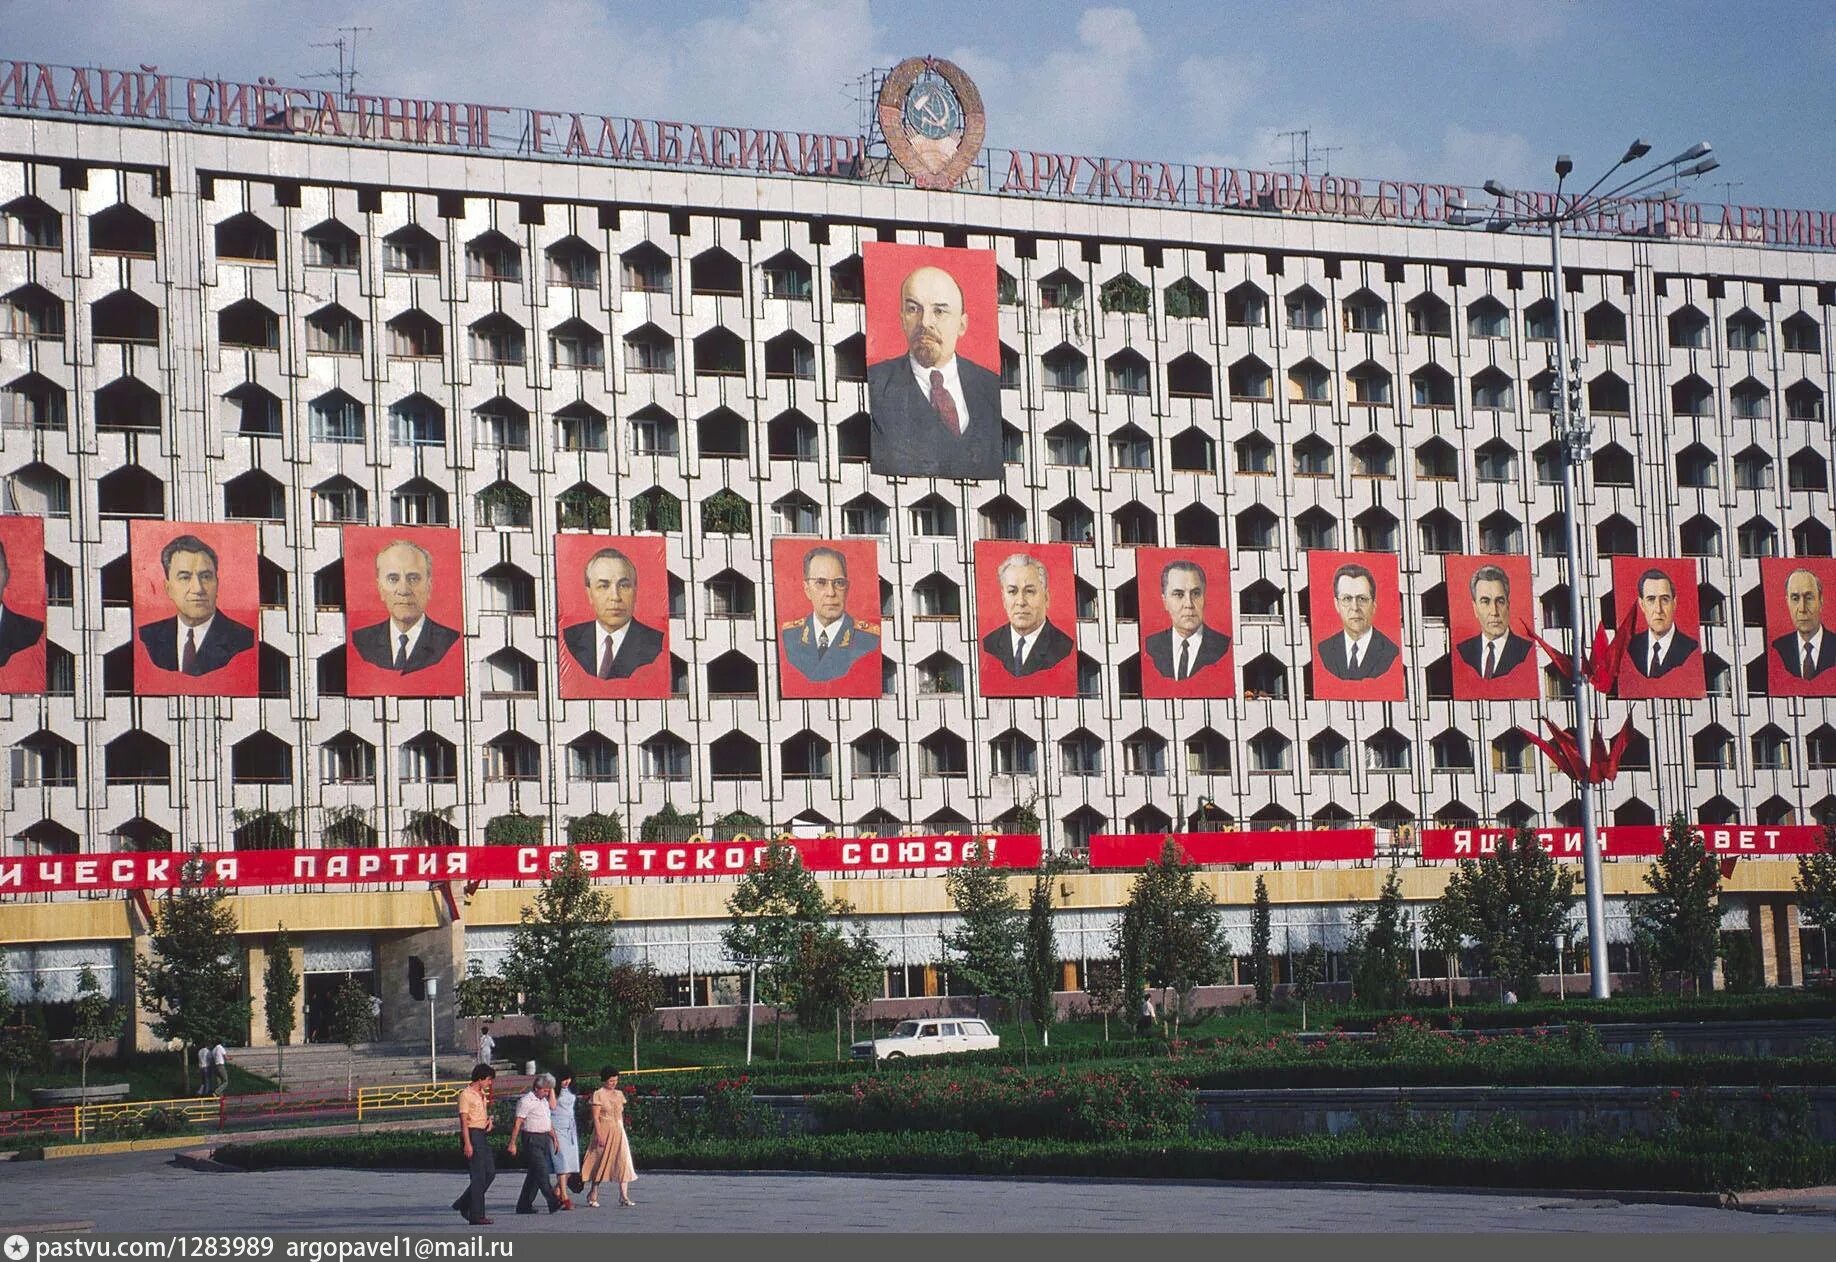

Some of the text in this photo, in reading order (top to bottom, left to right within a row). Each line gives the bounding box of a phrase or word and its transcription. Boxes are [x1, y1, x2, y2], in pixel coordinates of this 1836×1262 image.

[1001, 149, 1179, 202] ДРУЖБА
[1195, 165, 1364, 216] НАРОДОВ
[1716, 202, 1836, 248] ЛЕНИН
[294, 852, 468, 878] ПАРТИЯ
